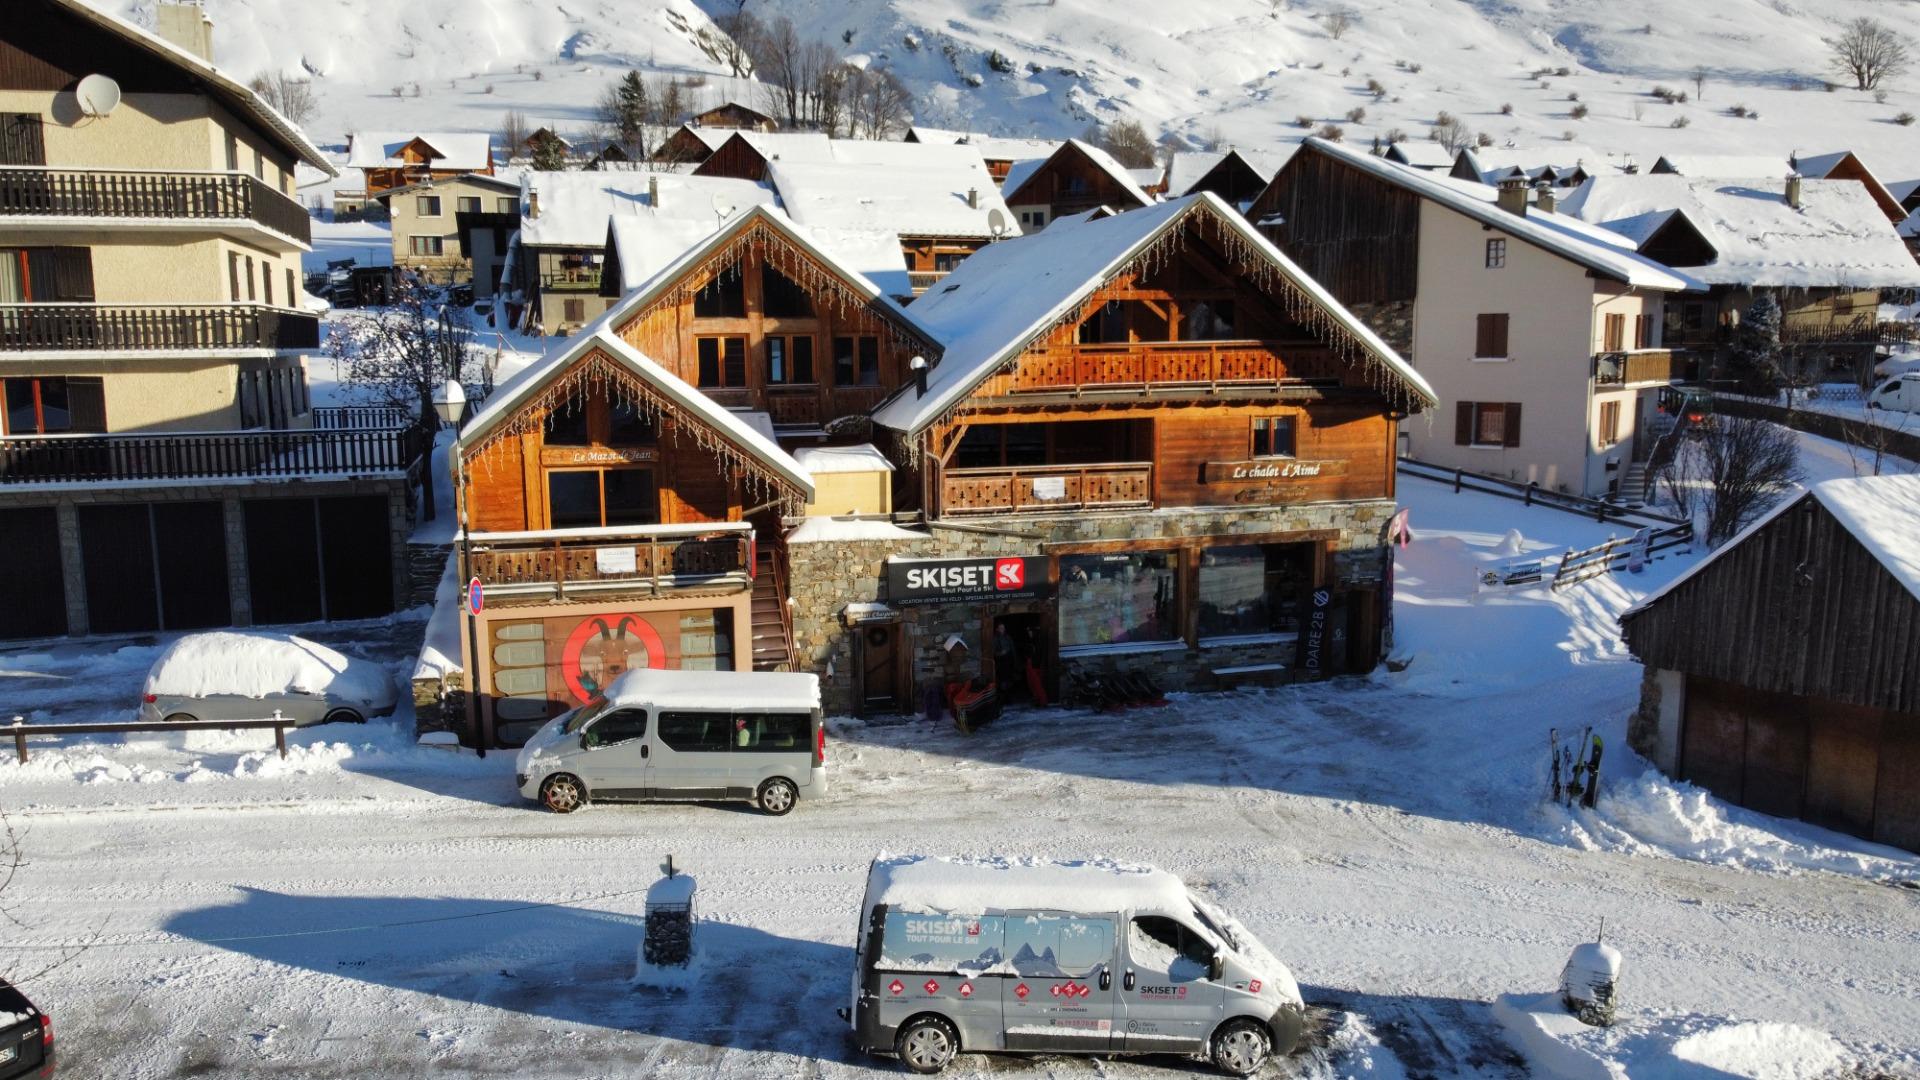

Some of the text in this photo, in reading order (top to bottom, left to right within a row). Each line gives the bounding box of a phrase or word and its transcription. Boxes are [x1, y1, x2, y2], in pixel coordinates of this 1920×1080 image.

[574, 449, 651, 462] Le Mazot de Jean
[1233, 463, 1320, 478] Le chalet d'Aimé
[907, 566, 993, 588] SKISET
[906, 934, 979, 945] TOUT POUR LE SKI
[1140, 986, 1178, 995] SKISET
